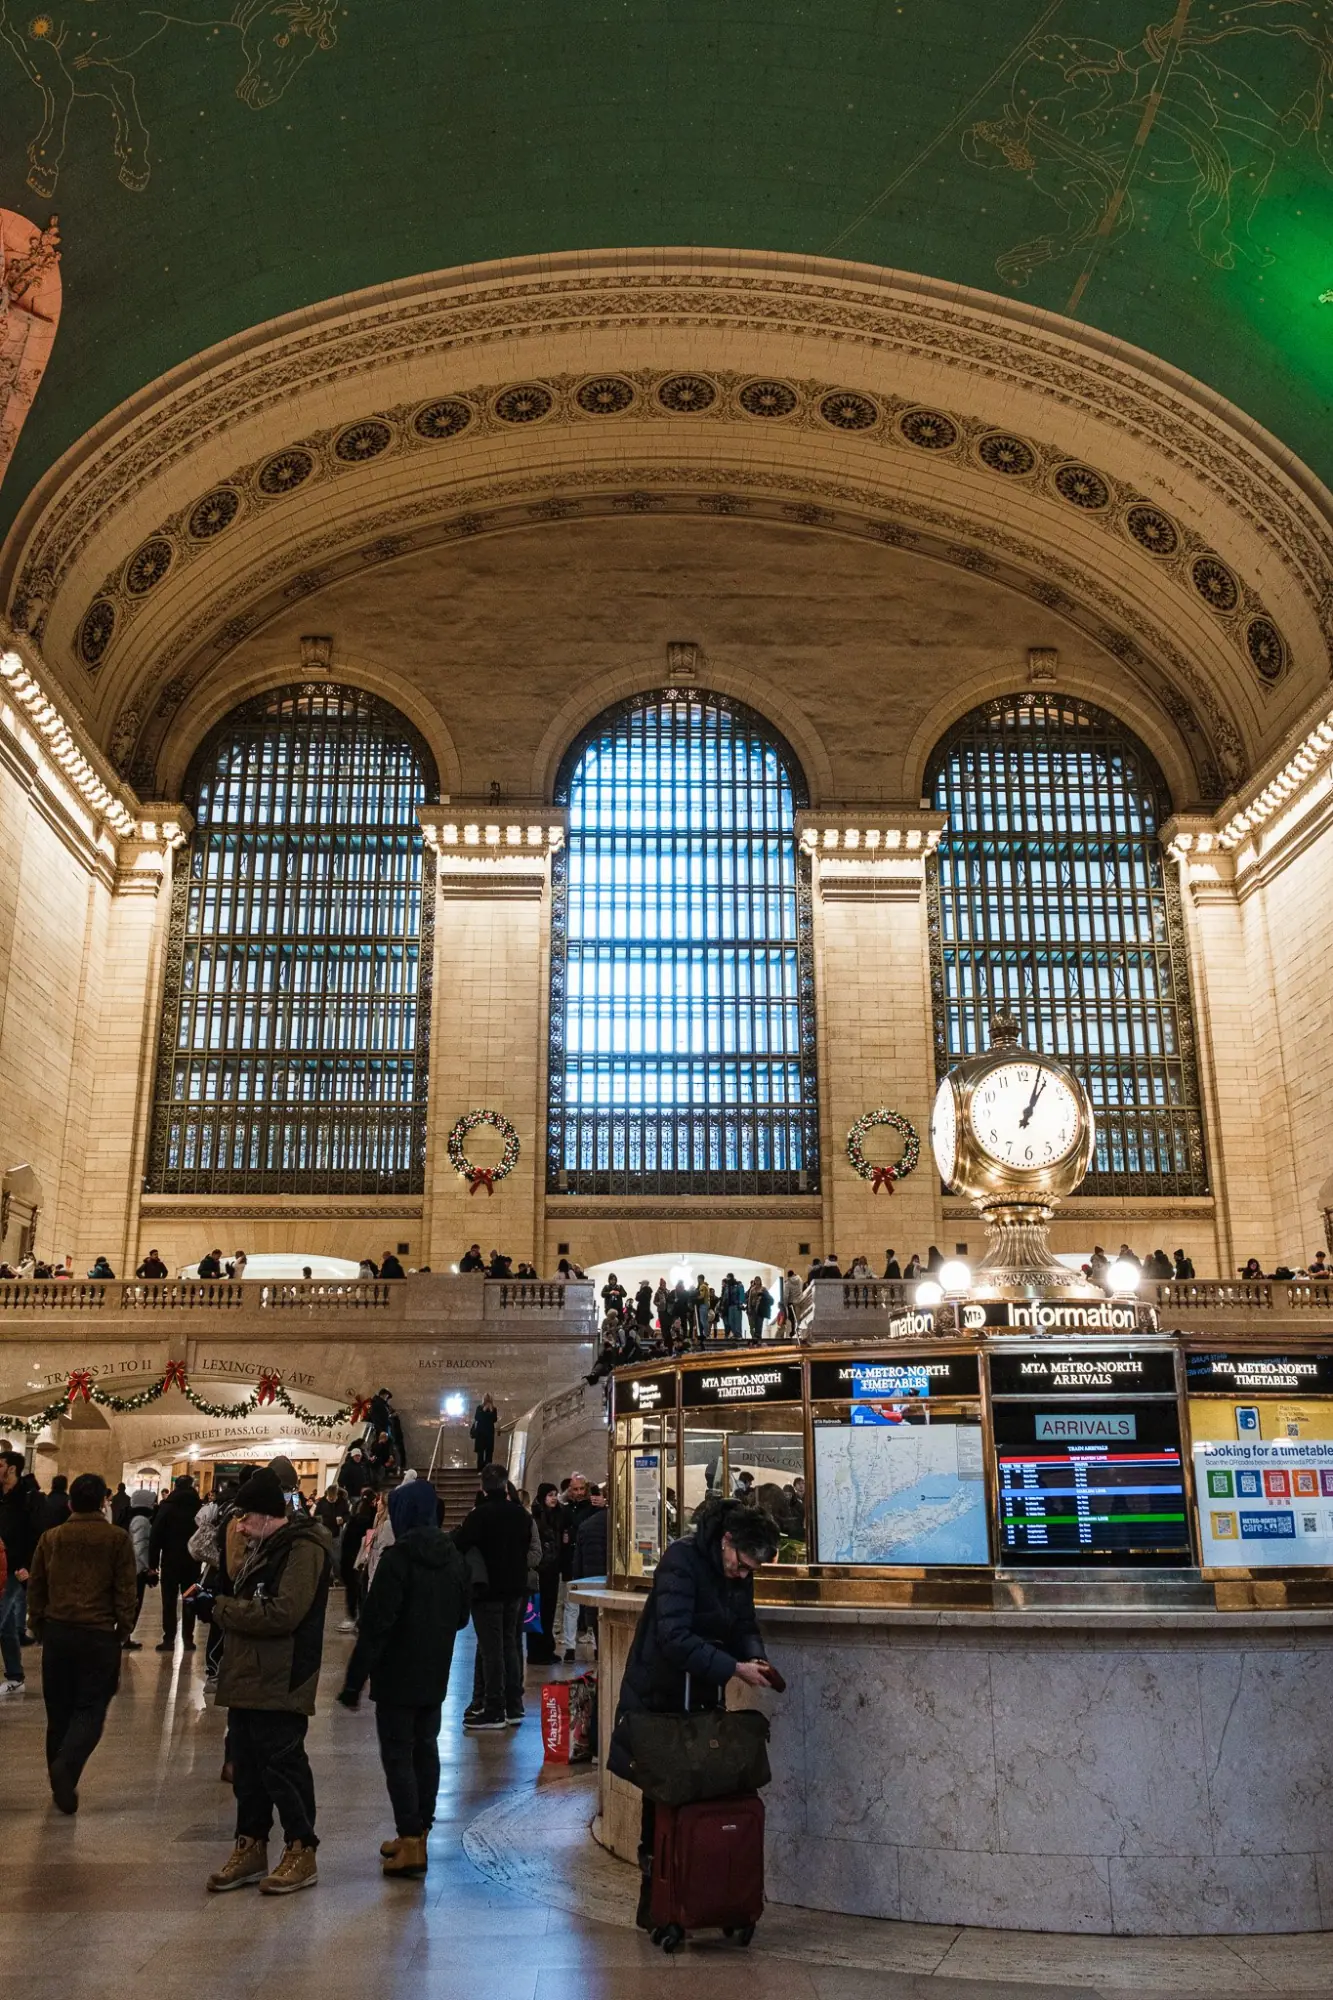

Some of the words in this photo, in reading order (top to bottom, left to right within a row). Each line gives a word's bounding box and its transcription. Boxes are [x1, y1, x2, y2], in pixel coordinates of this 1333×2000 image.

[999, 1076, 1008, 1089] 11
[1017, 1070, 1029, 1082] 12
[985, 1090, 996, 1103] 10
[990, 1129, 998, 1144] 8
[1058, 1128, 1066, 1142] 4
[1005, 1141, 1013, 1155] 7
[1025, 1145, 1033, 1160] 6
[1044, 1142, 1052, 1156] 5
[963, 1308, 983, 1325] MTA
[1008, 1302, 1135, 1328] Information
[103, 1364, 114, 1375] 21
[118, 1360, 138, 1373] TO
[418, 1360, 443, 1368] EAST
[446, 1359, 495, 1369] BALCONY
[1021, 1363, 1047, 1374] MTA
[1051, 1361, 1143, 1374] METRO-NORTH
[1212, 1362, 1236, 1373] MTA
[1238, 1362, 1317, 1374] METRO-NORTH
[202, 1359, 286, 1379] LEXINGTON
[288, 1371, 315, 1386] AVE
[839, 1369, 863, 1379] MTA
[865, 1365, 950, 1378] METRO-NORTH
[702, 1378, 718, 1388] MTA
[721, 1373, 781, 1387] METRO-NORTH
[861, 1378, 928, 1390] TIMETABLES
[1053, 1373, 1113, 1385] ARRIVALS
[1234, 1375, 1298, 1386] TIMETABLES
[717, 1385, 766, 1398] TIMETABLES
[1042, 1421, 1130, 1435] ARRIVALS
[152, 1436, 180, 1448] 42ND
[182, 1429, 221, 1442] STREET
[224, 1426, 270, 1436] PASSAGE
[280, 1426, 323, 1437] SUBWAY
[1252, 1445, 1269, 1456] for
[1271, 1447, 1278, 1456] a
[1280, 1445, 1333, 1456] timetable
[782, 1457, 802, 1468] CON
[1242, 1524, 1263, 1533] care
[546, 1697, 557, 1753] Marshalls
